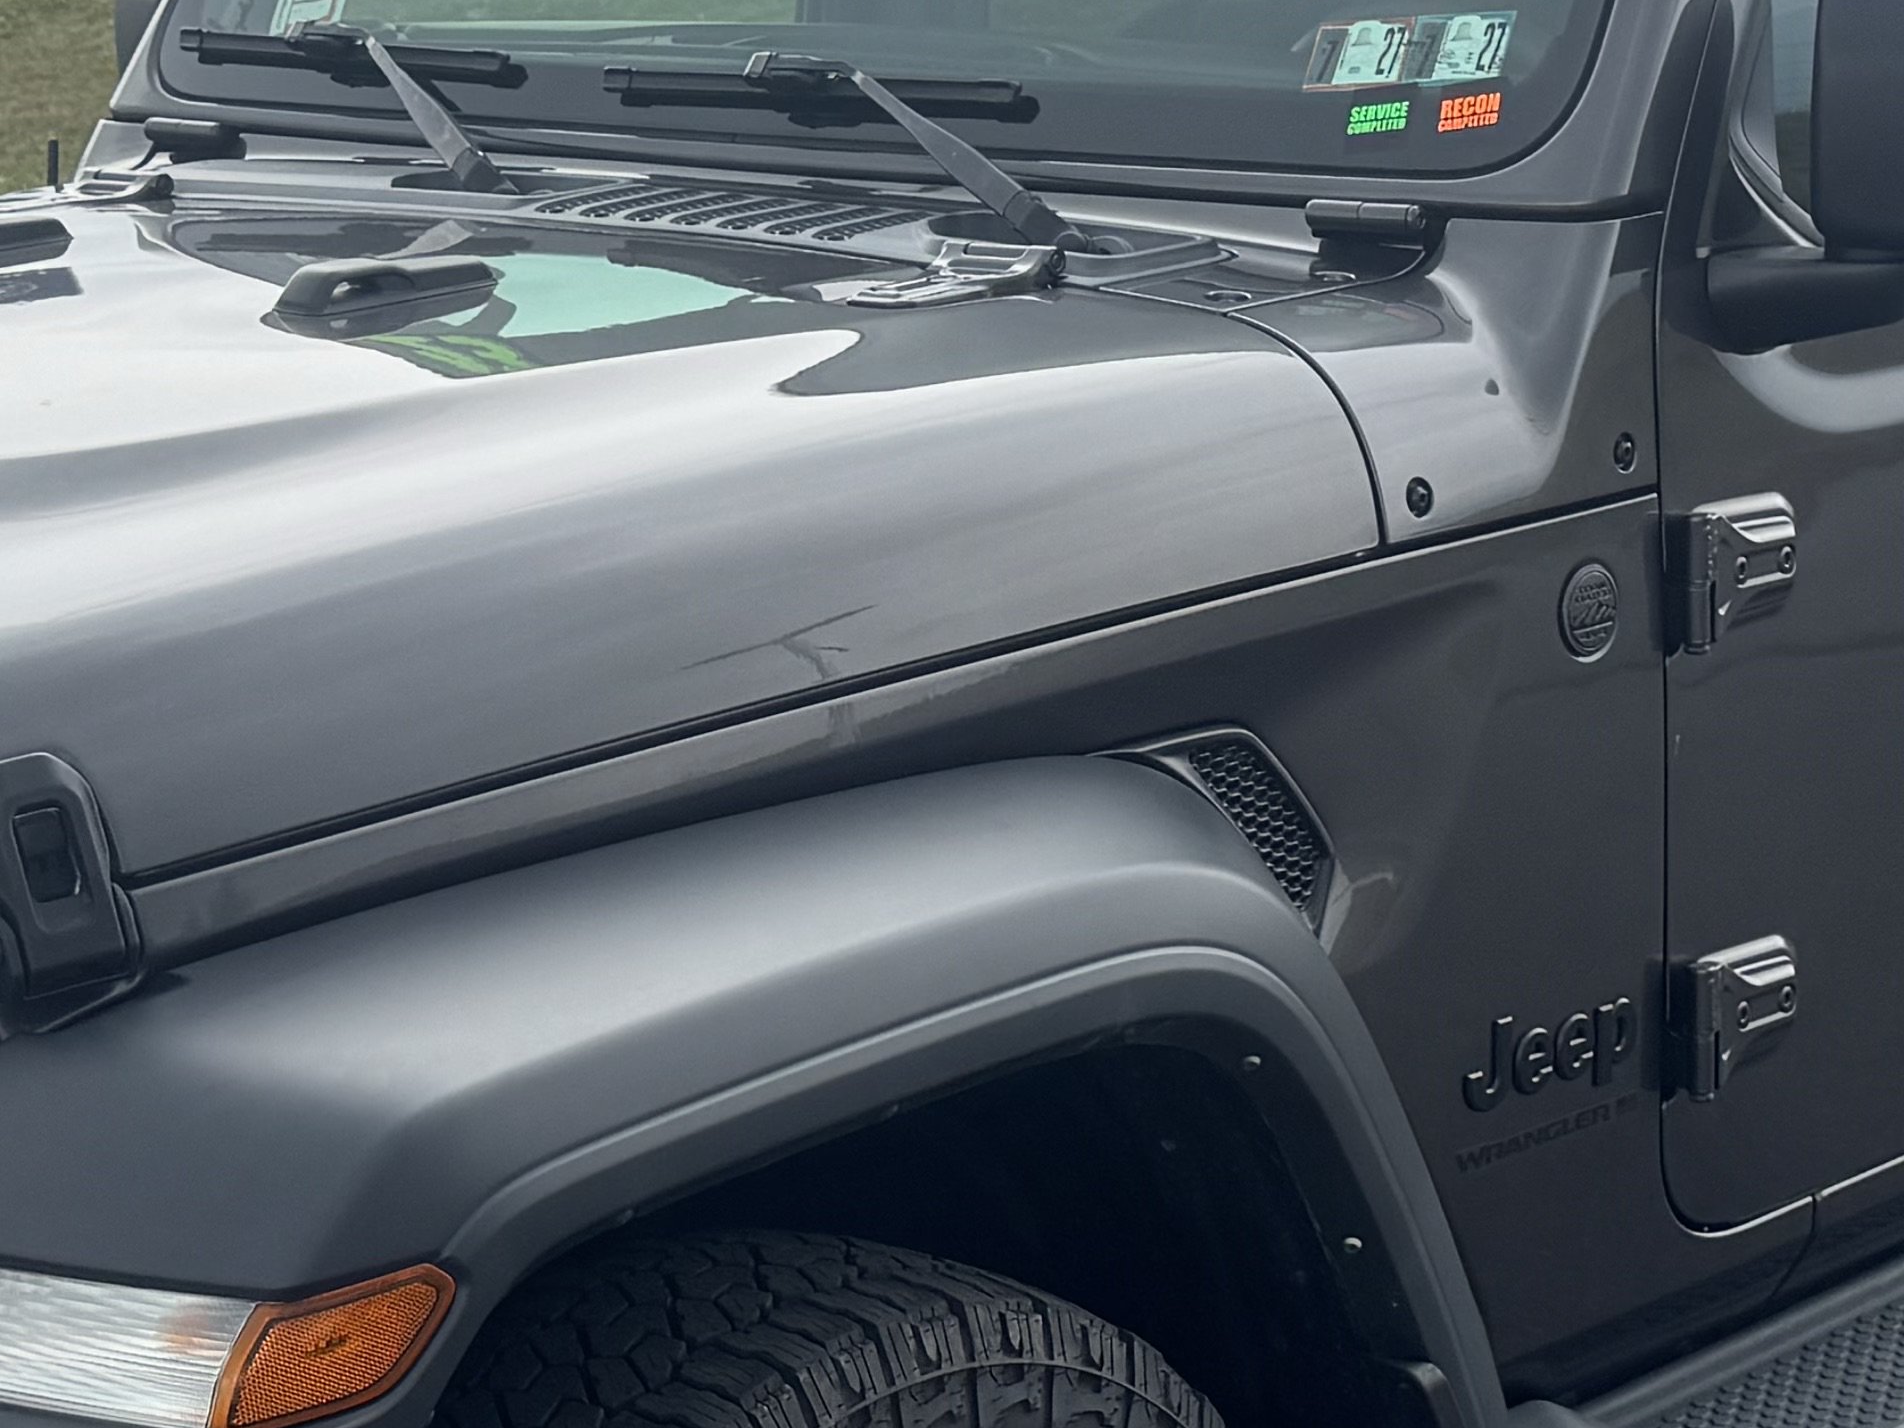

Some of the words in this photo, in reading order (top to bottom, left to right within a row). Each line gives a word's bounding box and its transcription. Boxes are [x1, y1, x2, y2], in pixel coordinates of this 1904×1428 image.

[1376, 27, 1407, 76] 27
[1475, 22, 1507, 72] 27
[1350, 102, 1410, 122] SERVICE
[1441, 92, 1501, 120] RECON
[1462, 996, 1637, 1112] Jeep
[1456, 1104, 1611, 1172] WRANGLER
